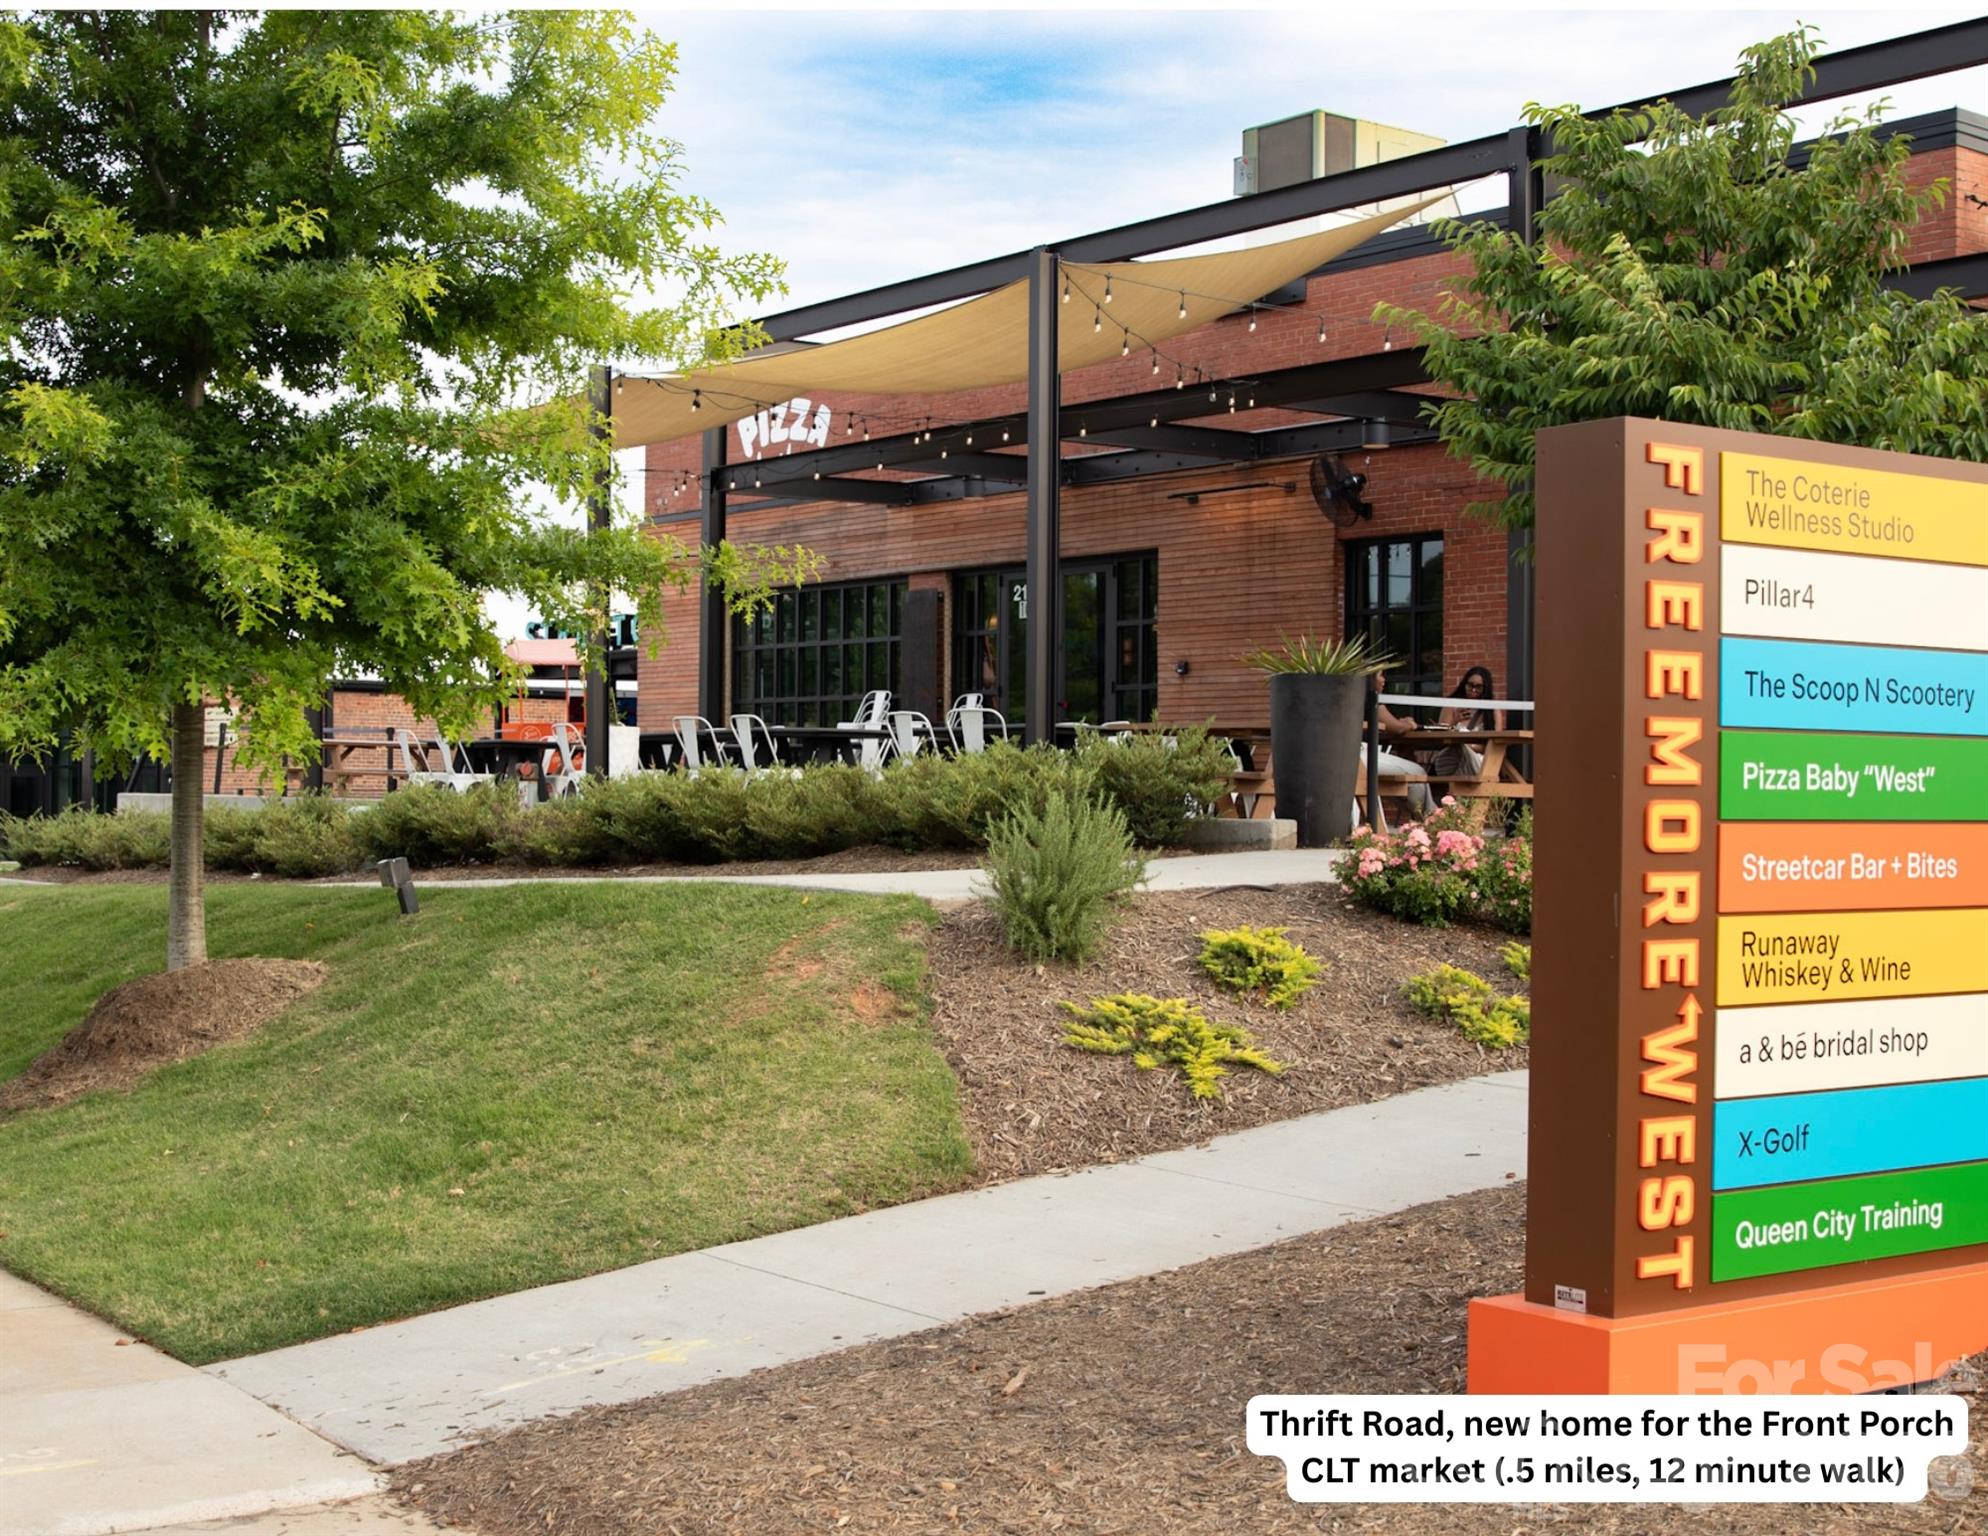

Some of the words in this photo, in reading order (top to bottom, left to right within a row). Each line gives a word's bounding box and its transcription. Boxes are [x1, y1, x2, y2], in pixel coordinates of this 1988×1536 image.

[737, 397, 831, 458] PIZZA
[1746, 470, 1787, 499] The
[1793, 475, 1870, 508] Coterie
[1746, 501, 1842, 536] Wellness
[1848, 512, 1914, 543] Studio
[1745, 578, 1815, 609] Pillar4
[1745, 670, 1785, 698] The
[1792, 673, 1859, 708] Scoop
[1865, 677, 1880, 703] N
[1886, 678, 1975, 713] Scootery
[1642, 441, 1704, 989] FREEMORE
[1743, 762, 1801, 790] Pizza
[1806, 763, 1859, 797] Baby
[1742, 853, 1846, 881] Streetcar
[1850, 852, 1887, 880] Bar
[1892, 858, 1903, 874] +
[1907, 852, 1958, 879] Bites
[1742, 931, 1840, 960] Runaway
[1742, 960, 1833, 991] Whiskey
[1839, 958, 1854, 984] &
[1860, 956, 1912, 982] Wine
[1740, 1043, 1751, 1064] a
[1758, 1036, 1774, 1063] &
[1781, 1032, 1807, 1061] bé
[1813, 1028, 1874, 1059] bridal
[1879, 1027, 1929, 1057] shop
[1636, 993, 1702, 1290] WEST
[1738, 1123, 1810, 1158] X-Golf
[1735, 1220, 1808, 1249] Queen
[1813, 1209, 1856, 1241] City
[1860, 1199, 1943, 1231] Training
